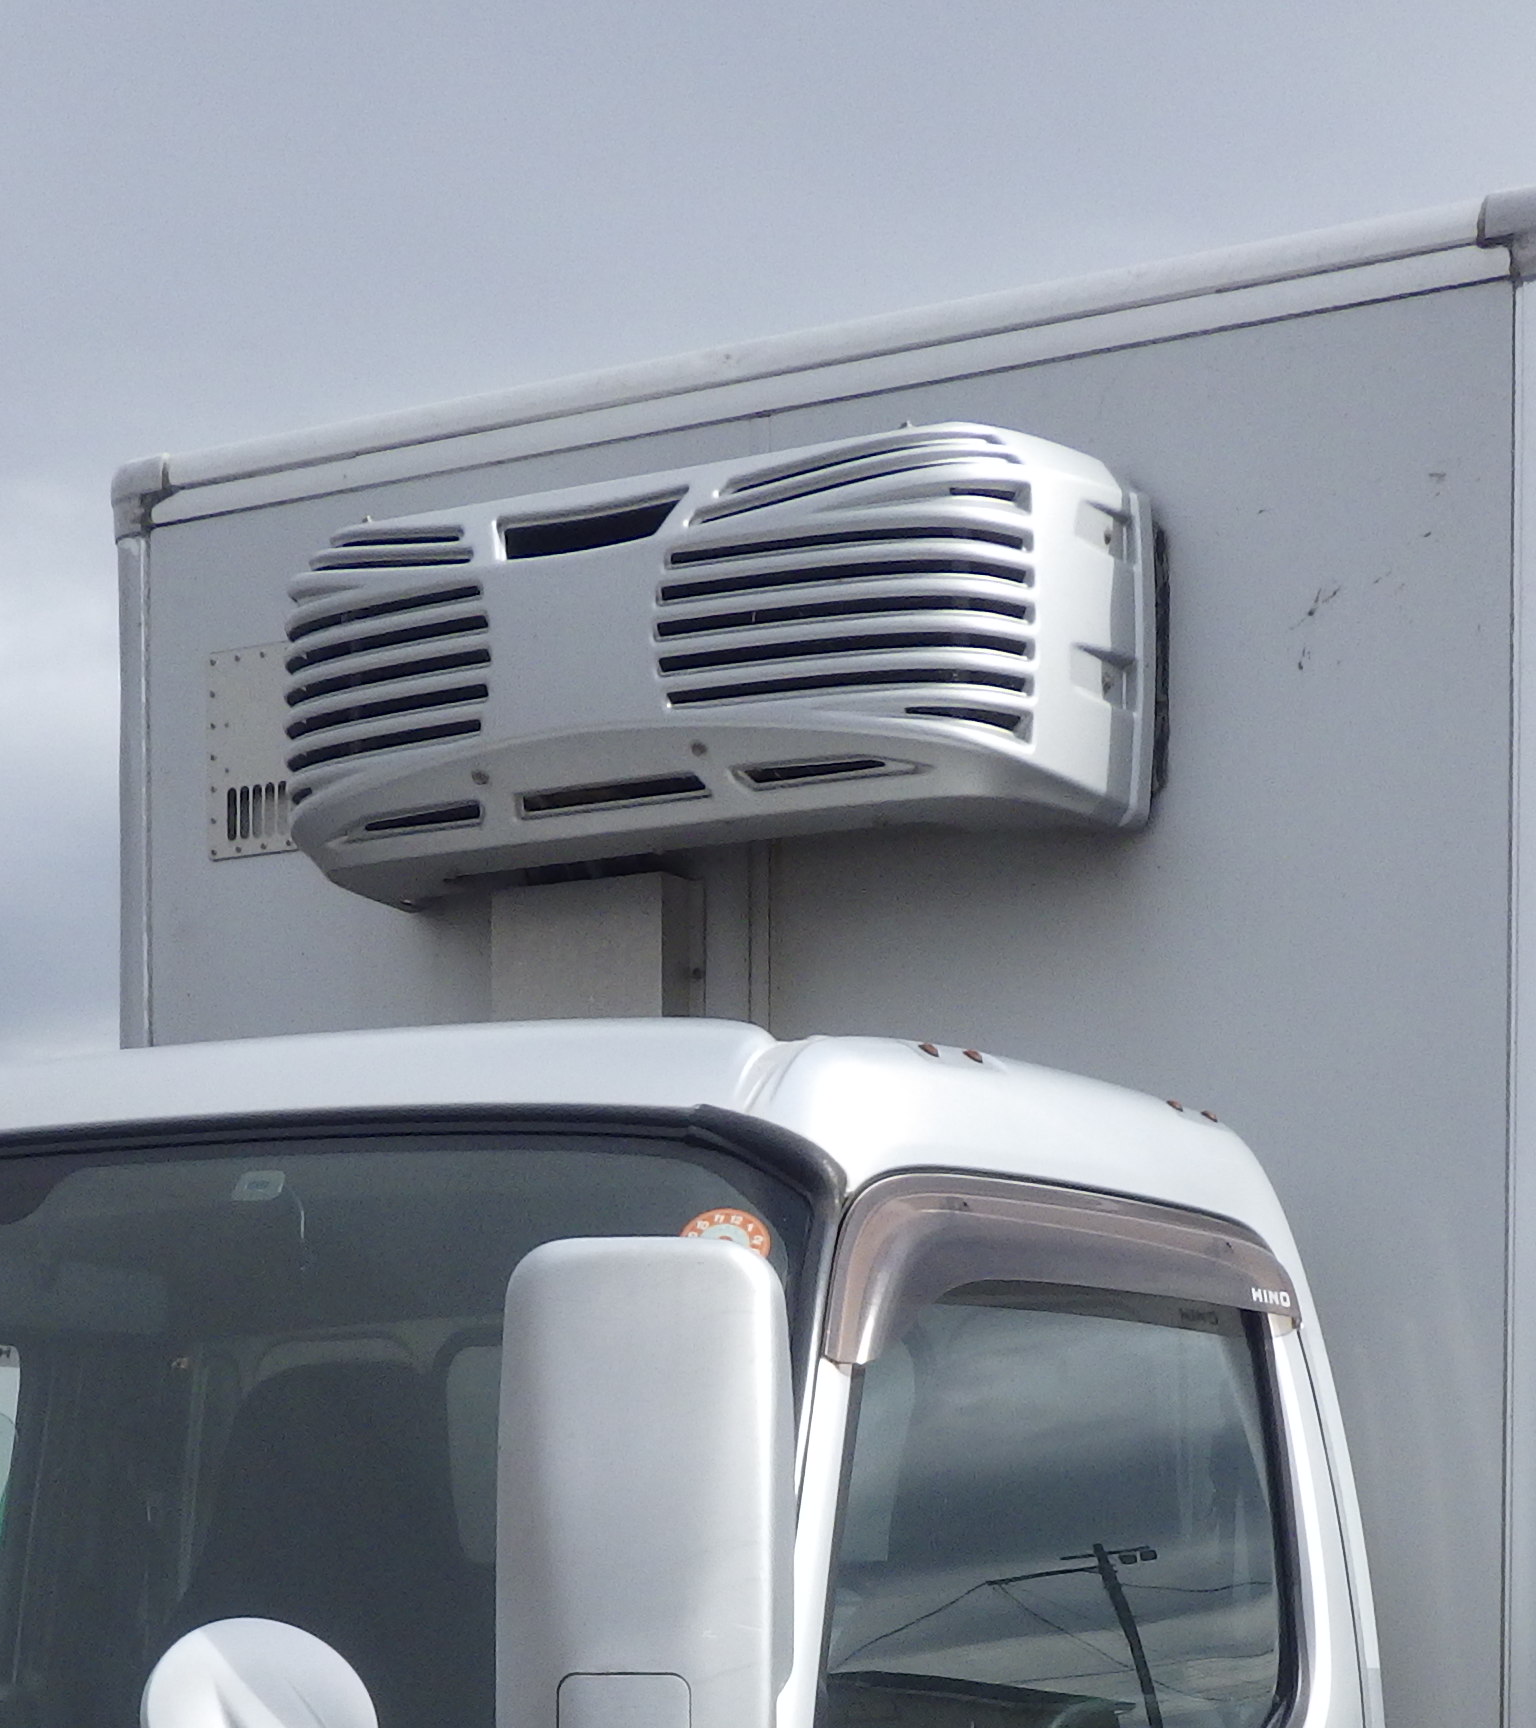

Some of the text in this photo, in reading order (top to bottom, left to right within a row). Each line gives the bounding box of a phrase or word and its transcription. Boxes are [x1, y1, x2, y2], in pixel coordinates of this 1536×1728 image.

[696, 1221, 710, 1231] 10
[731, 1214, 743, 1225] 12
[1251, 1287, 1292, 1308] HINO
